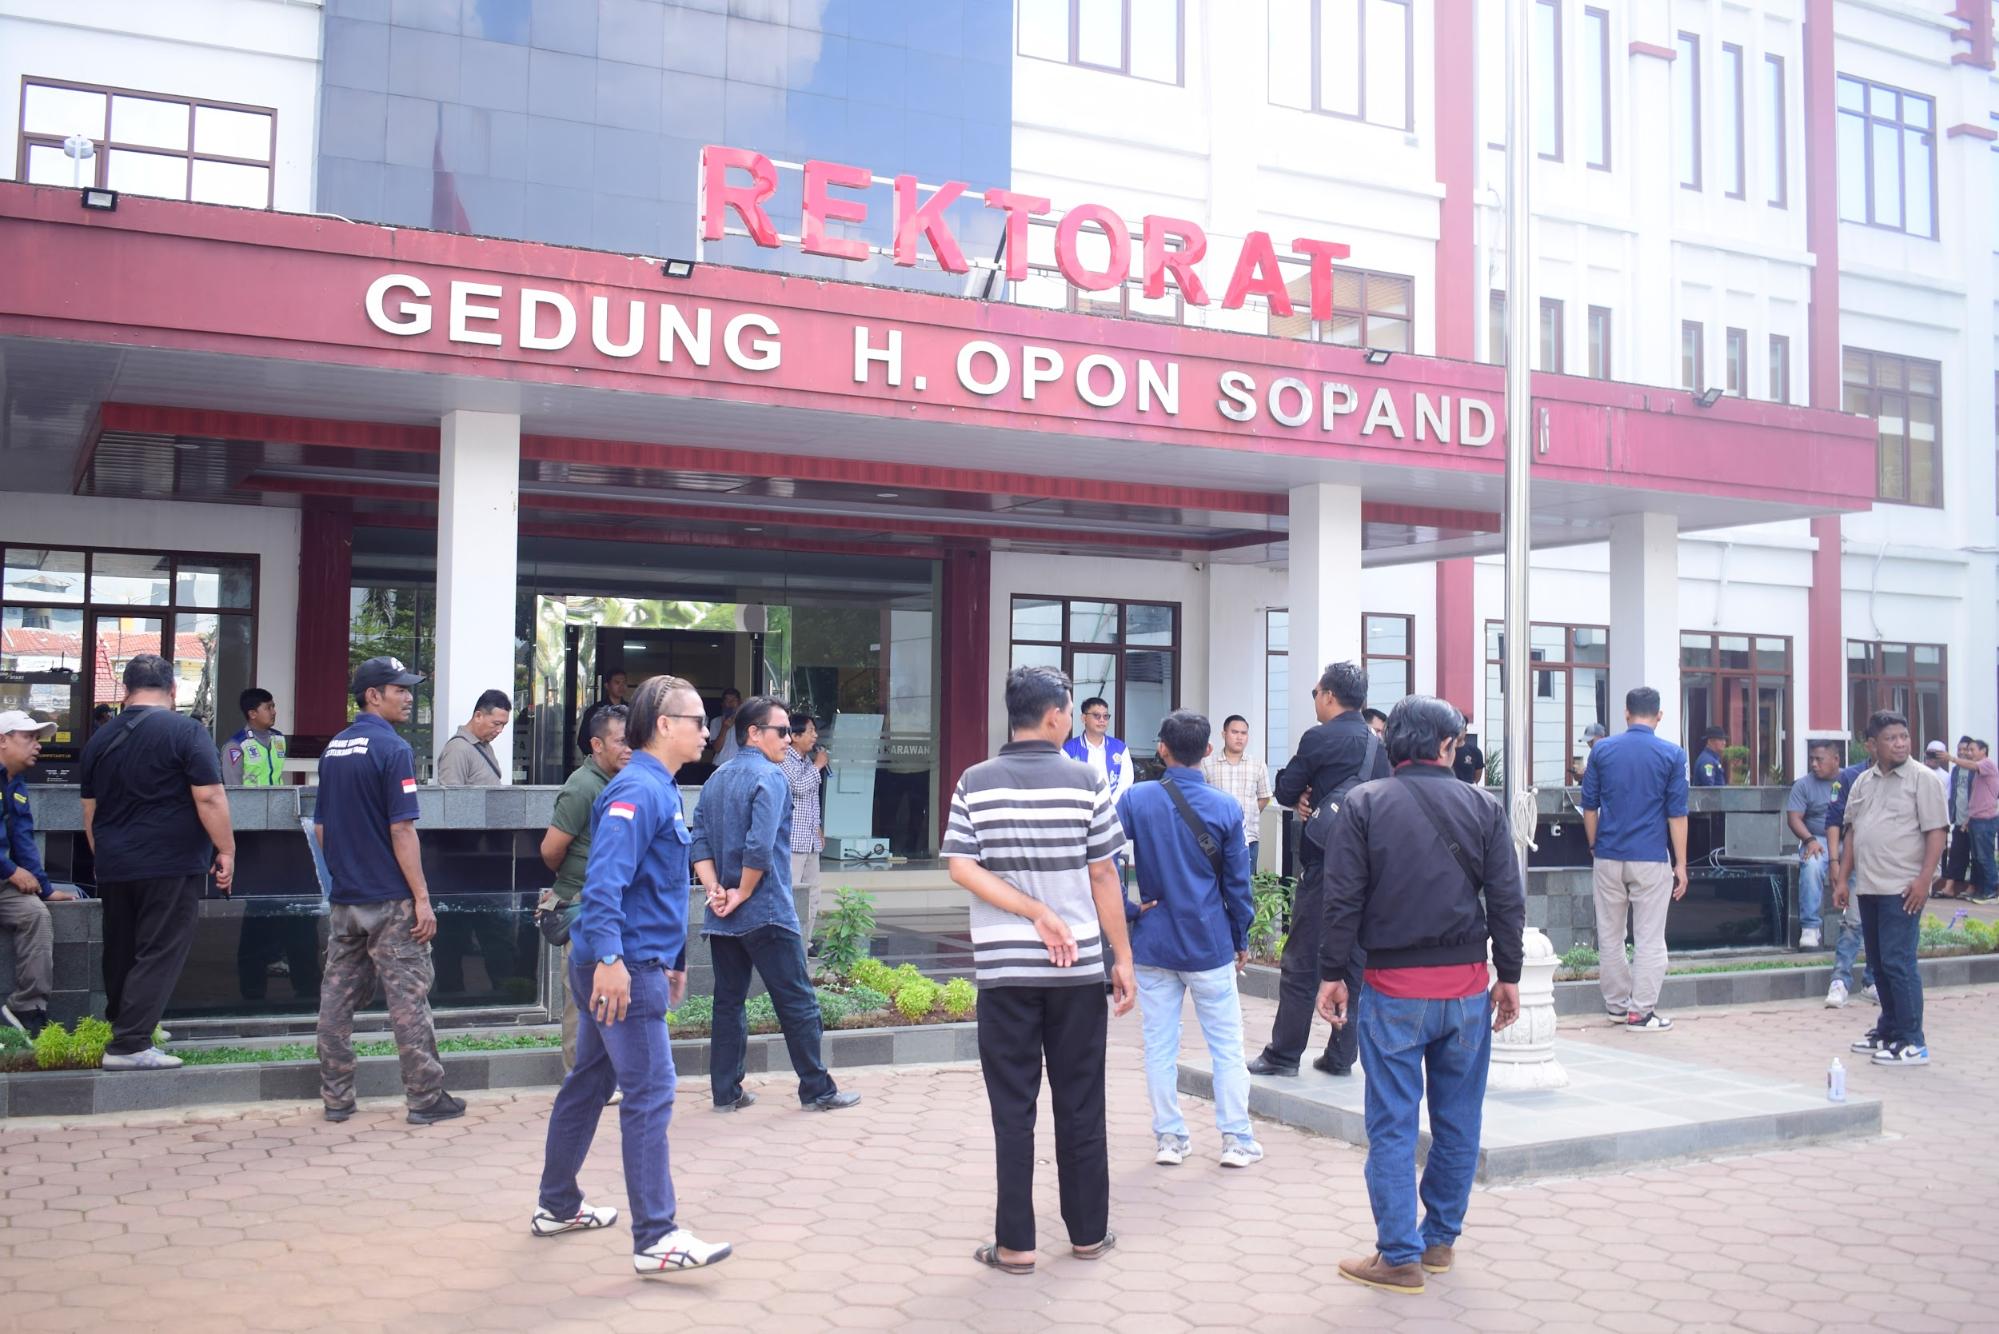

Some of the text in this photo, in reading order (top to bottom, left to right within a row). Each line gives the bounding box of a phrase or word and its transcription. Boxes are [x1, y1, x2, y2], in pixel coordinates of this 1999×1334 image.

[701, 145, 1350, 321] REKTORAT
[365, 273, 1550, 454] GEDUNG H. OPON SOPANDI
